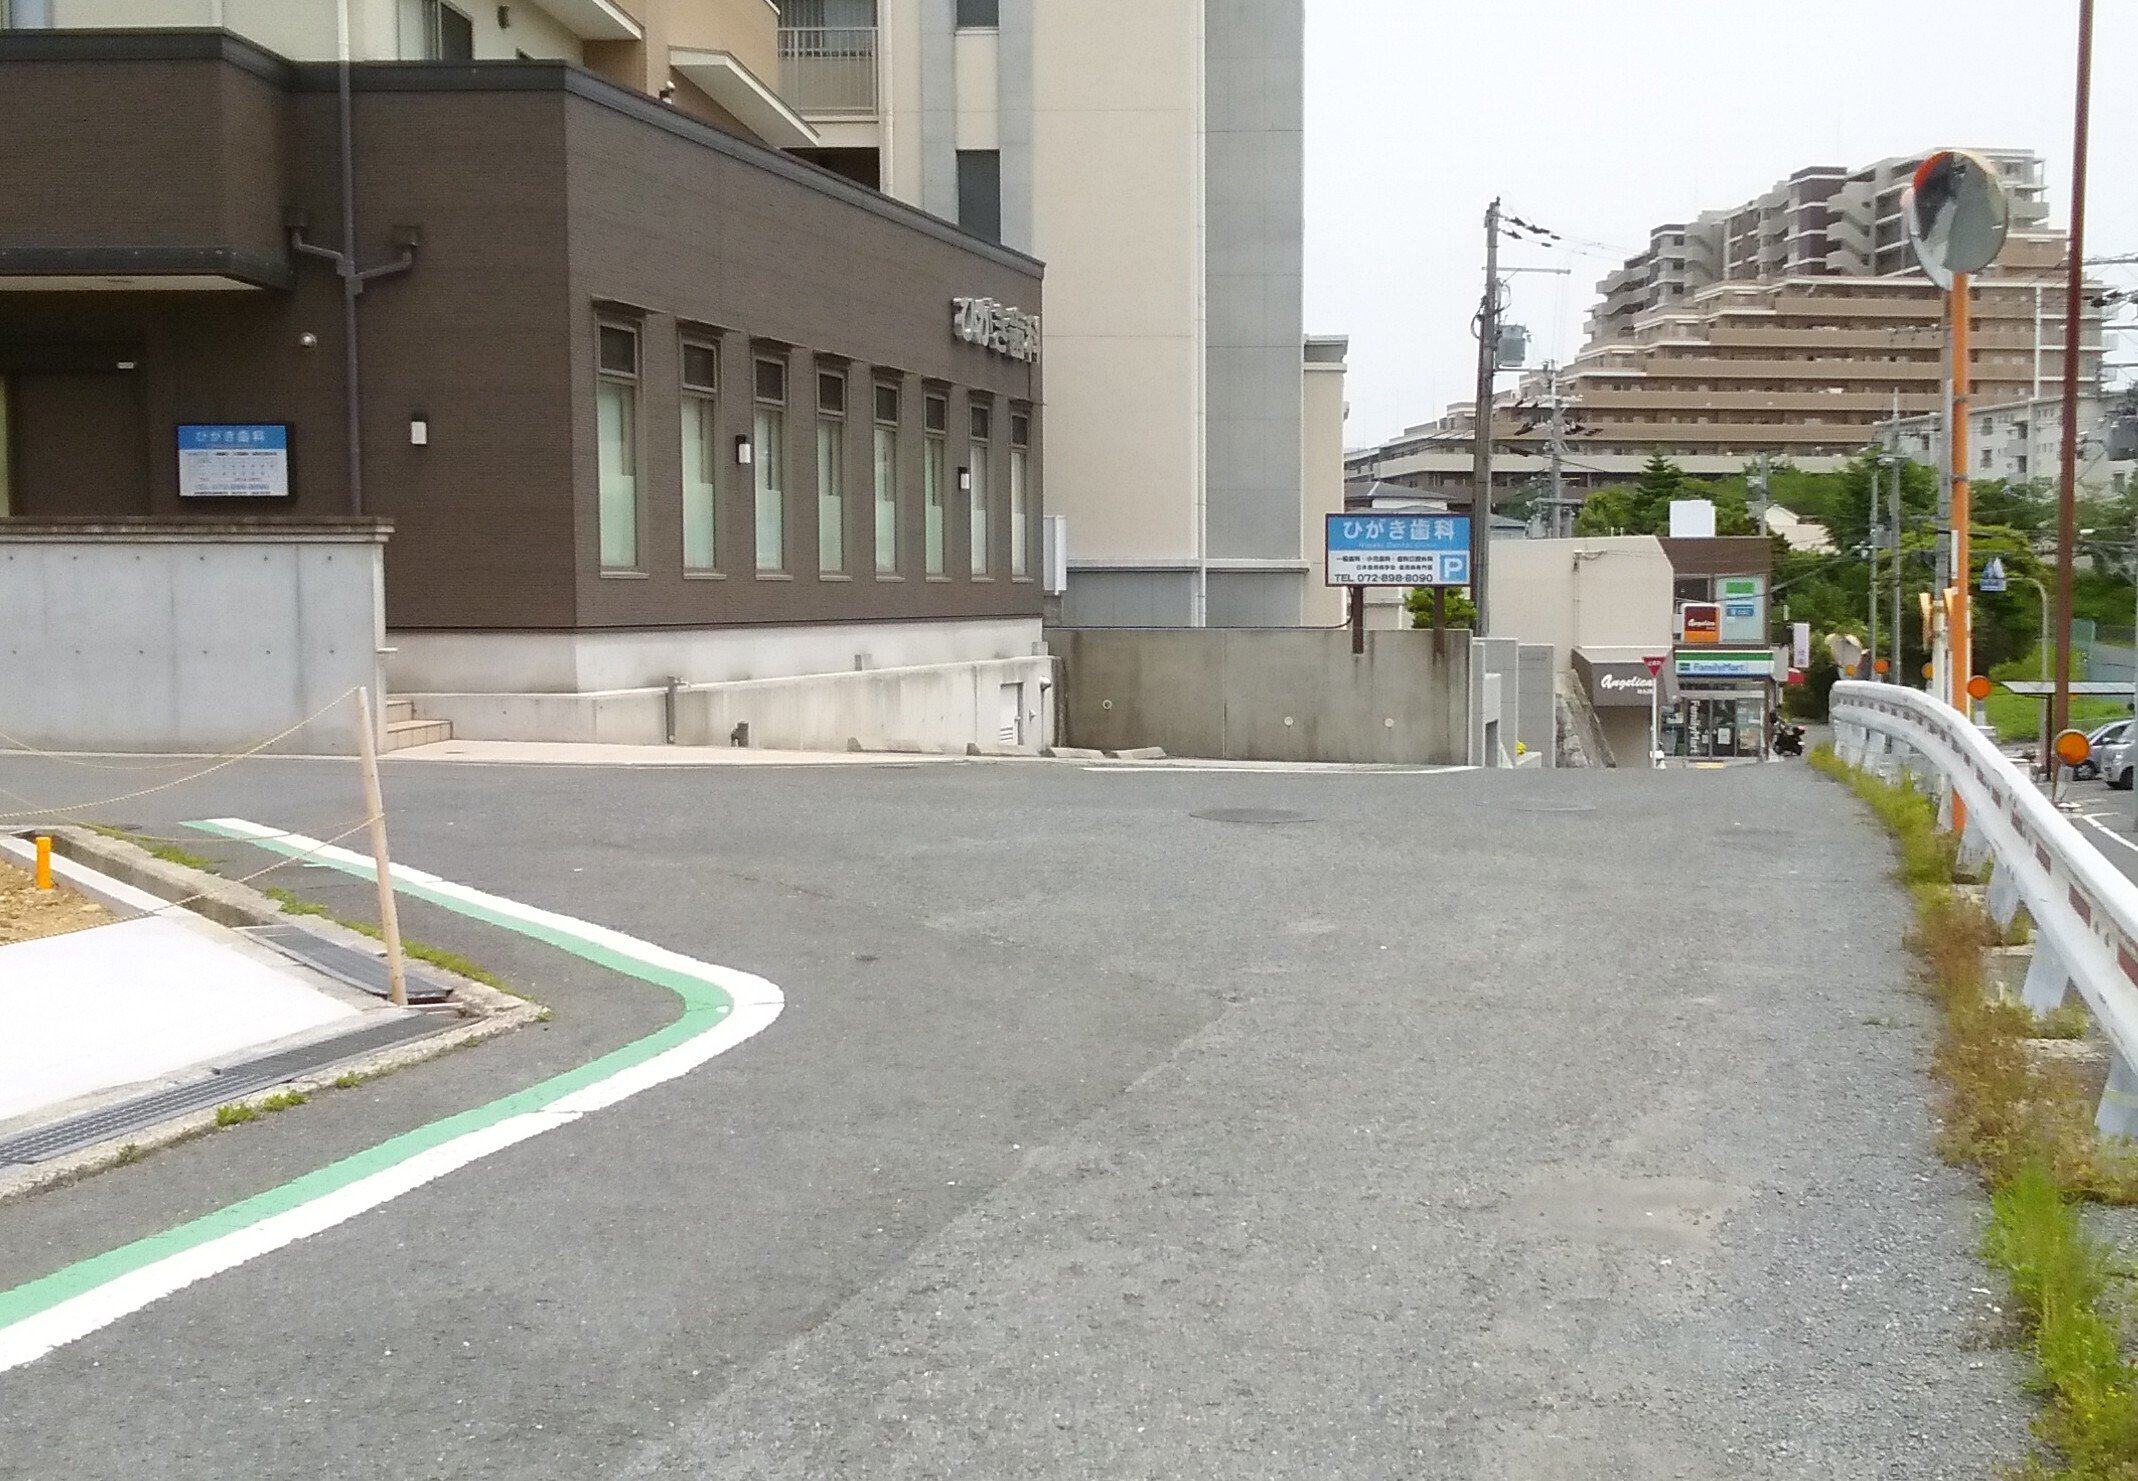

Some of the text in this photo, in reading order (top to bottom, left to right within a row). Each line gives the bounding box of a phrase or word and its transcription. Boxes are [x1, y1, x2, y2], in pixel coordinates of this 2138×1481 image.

[1342, 519, 1456, 541] ひがき歯科
[1444, 557, 1463, 579] P
[1334, 574, 1434, 582] TEL 072-898-8090
[1693, 662, 1744, 673] FamilyMart
